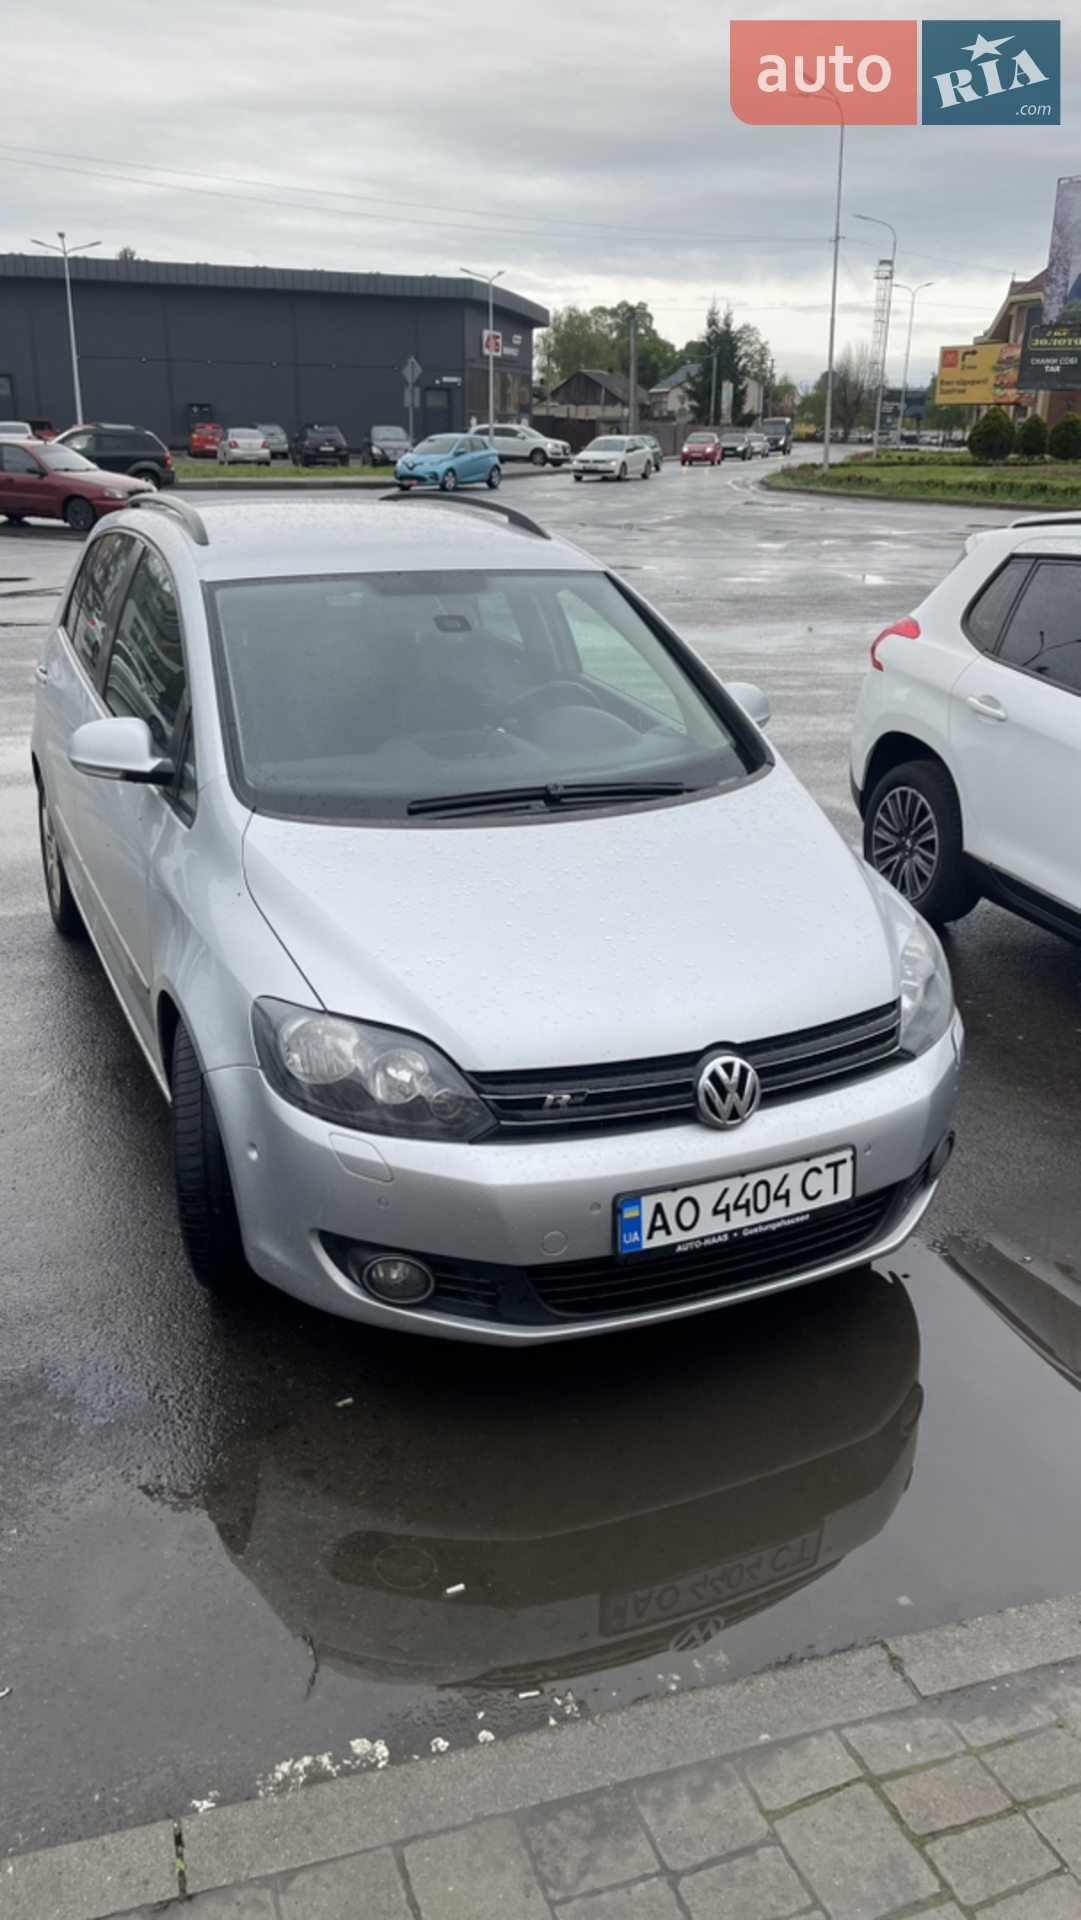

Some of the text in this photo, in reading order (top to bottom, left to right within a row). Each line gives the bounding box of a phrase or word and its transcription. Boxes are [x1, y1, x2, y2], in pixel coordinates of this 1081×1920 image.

[646, 1157, 848, 1241] AO 4404 CT
[623, 1230, 641, 1245] UA
